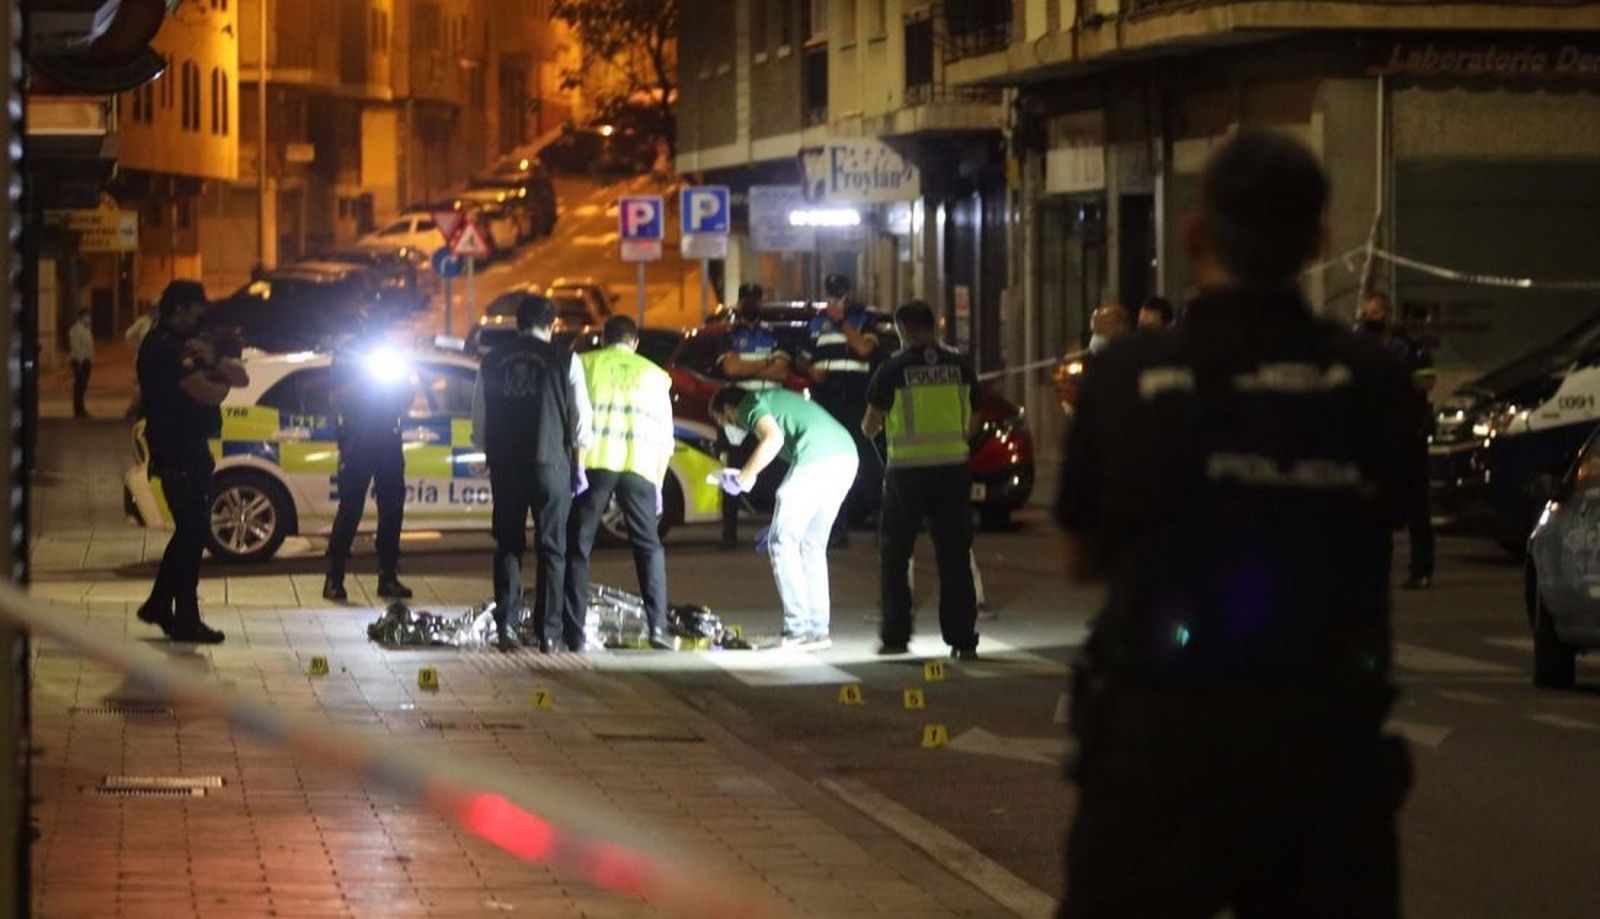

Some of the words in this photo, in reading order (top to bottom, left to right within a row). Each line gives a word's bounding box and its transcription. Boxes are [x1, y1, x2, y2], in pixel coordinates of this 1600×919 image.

[1389, 42, 1547, 72] Laboratorio
[627, 201, 655, 236] P
[691, 192, 720, 230] P
